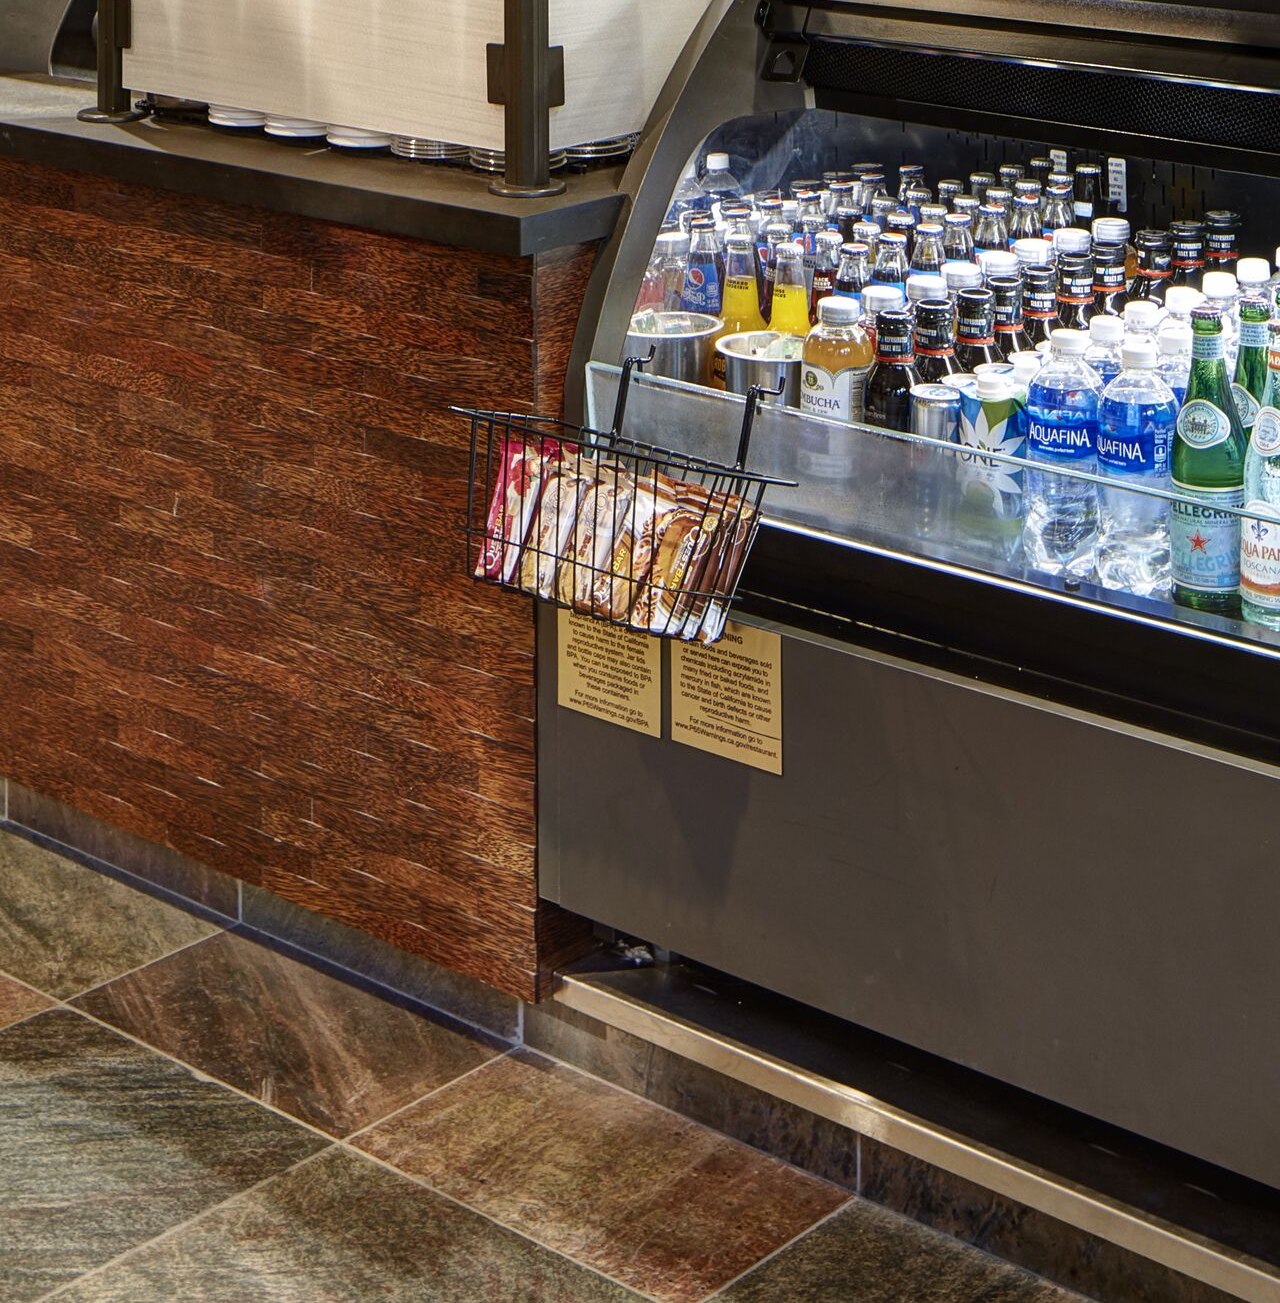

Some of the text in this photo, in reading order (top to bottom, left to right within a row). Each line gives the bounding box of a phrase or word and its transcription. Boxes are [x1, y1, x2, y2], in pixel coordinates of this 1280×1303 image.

[1030, 421, 1091, 447] AQUAFINA
[1097, 434, 1145, 463] QUAFINA
[1242, 539, 1259, 558] QUA
